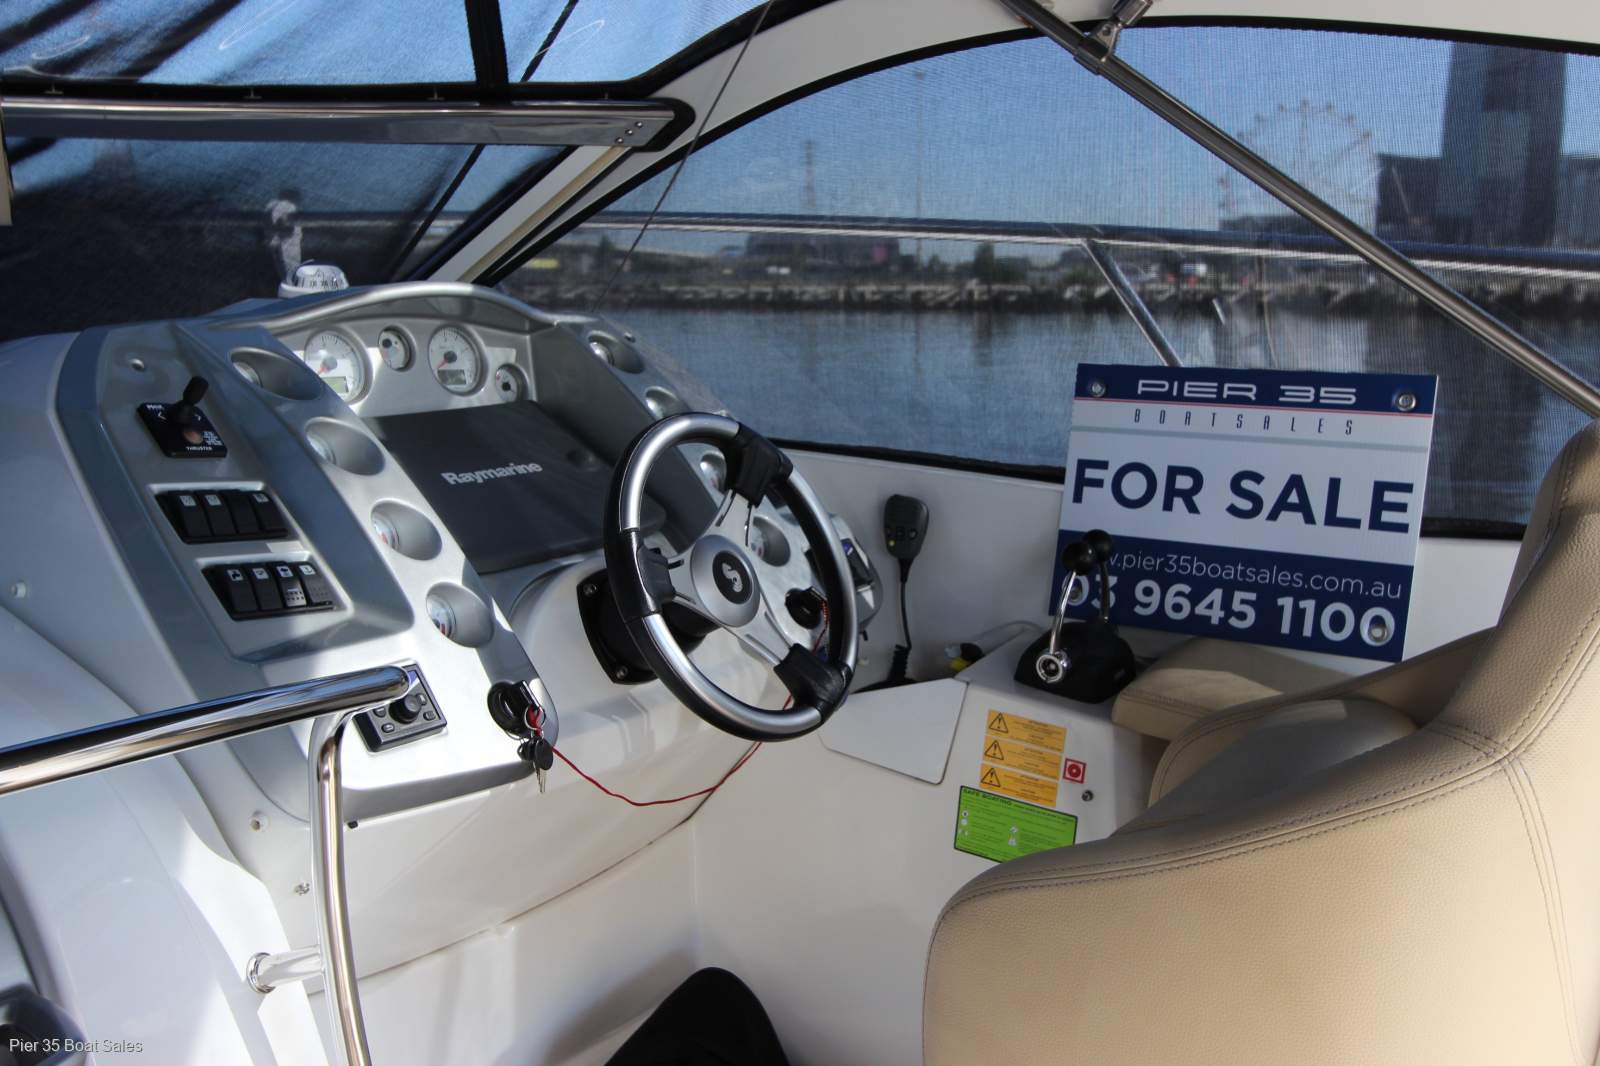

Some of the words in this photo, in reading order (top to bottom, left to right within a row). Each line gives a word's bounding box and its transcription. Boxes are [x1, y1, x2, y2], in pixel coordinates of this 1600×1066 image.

[1137, 379, 1257, 402] PIER
[1278, 384, 1357, 406] 35
[1134, 407, 1354, 436] BOATSALES
[441, 460, 543, 486] Raymarine
[1072, 458, 1205, 516] FOR
[1225, 469, 1414, 534] SALE
[1110, 550, 1402, 599] .pier35boatsales.com.au
[1133, 579, 1259, 630] 9645
[1276, 596, 1396, 647] 1100
